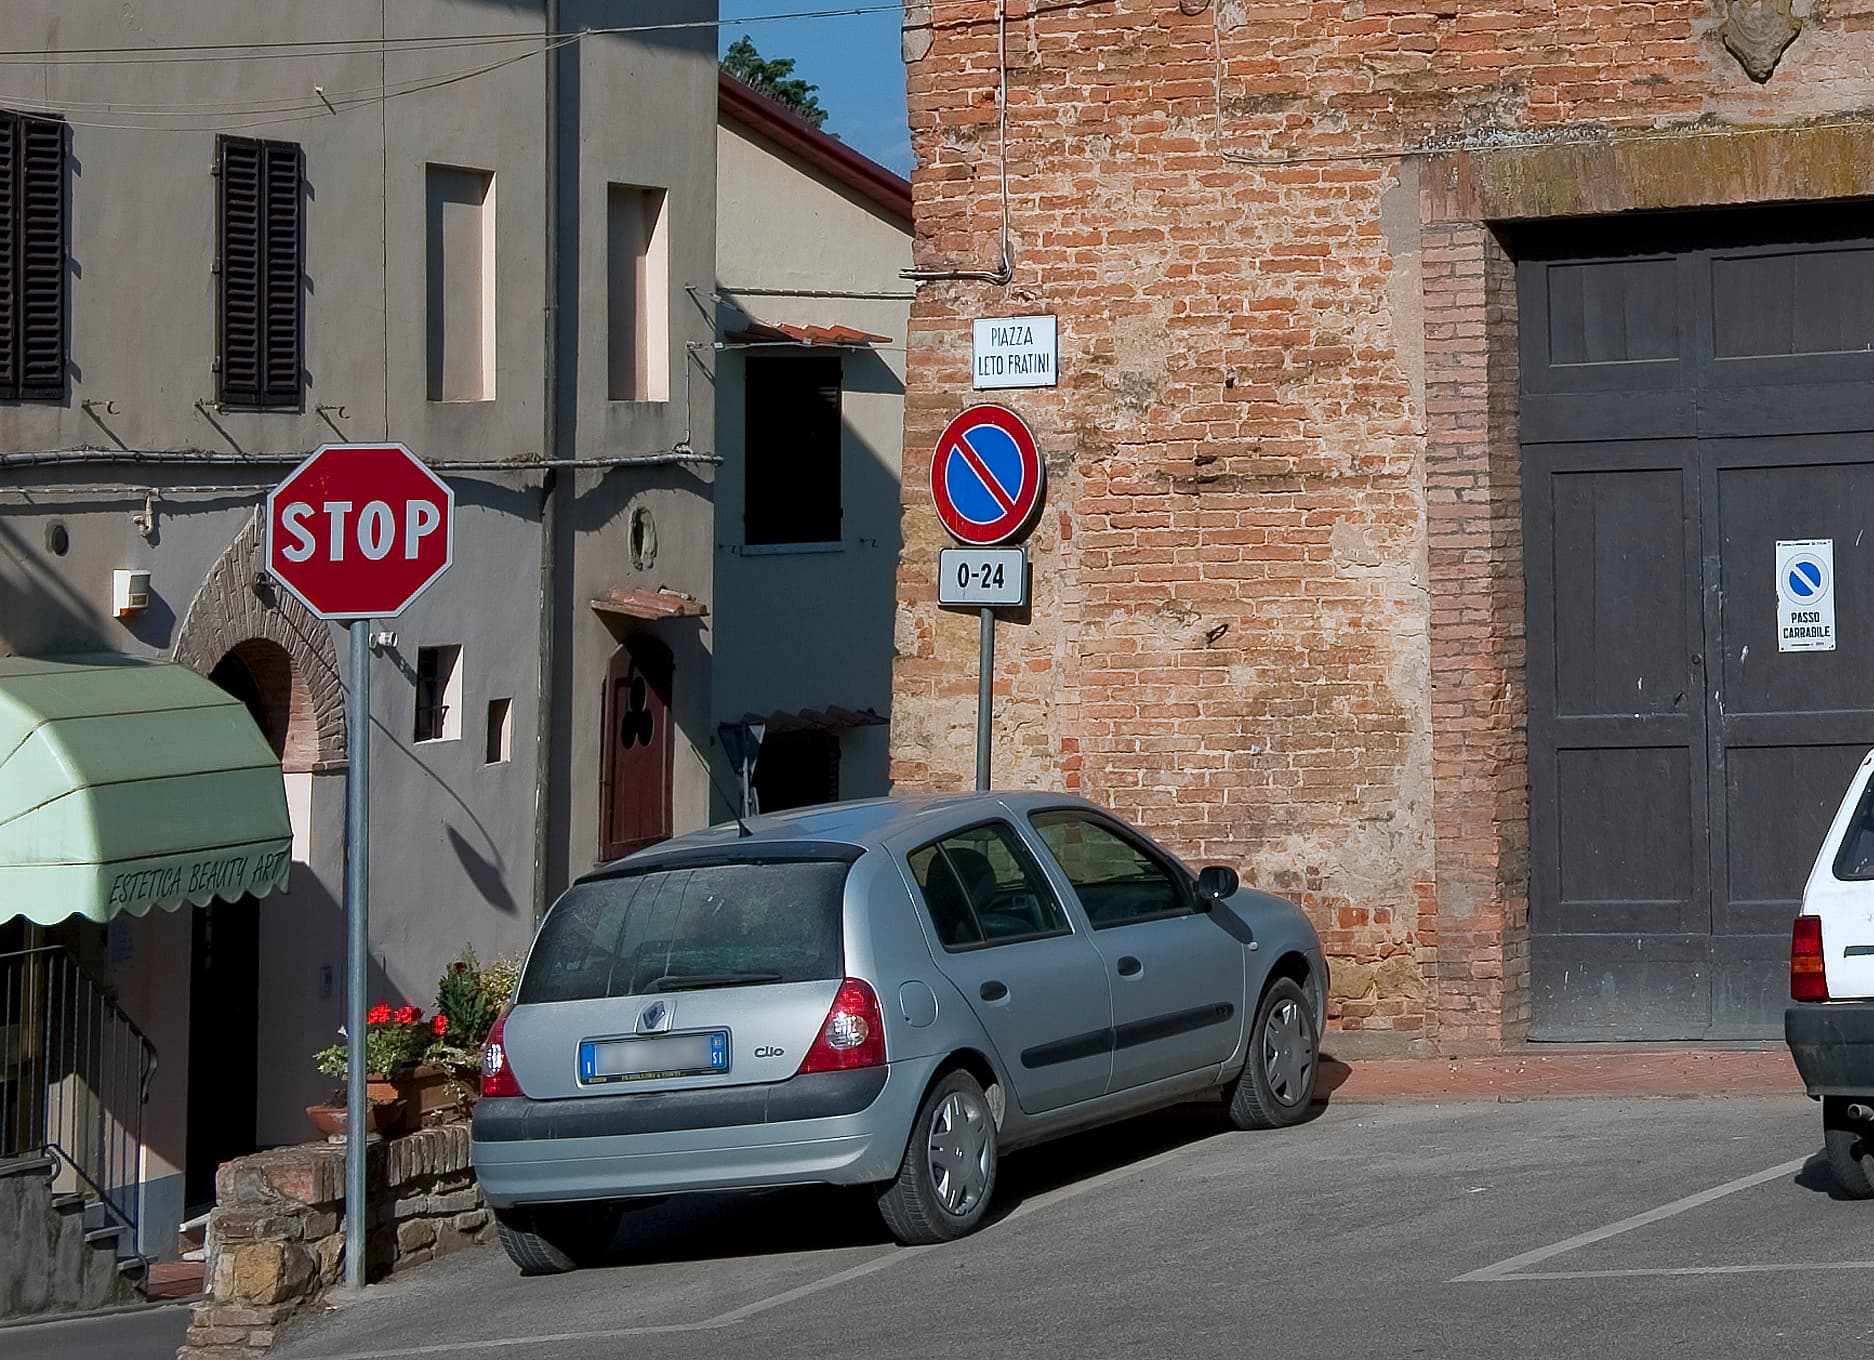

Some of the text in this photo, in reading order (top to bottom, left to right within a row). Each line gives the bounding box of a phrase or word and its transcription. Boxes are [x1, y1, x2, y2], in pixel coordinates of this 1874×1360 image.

[992, 326, 1034, 347] PIAZZA
[978, 353, 1050, 376] LETO FRATINI
[281, 499, 441, 563] STOP
[957, 562, 1005, 589] 0-24
[1791, 611, 1821, 624] PASSO
[1783, 625, 1831, 639] CARRABILE
[109, 866, 182, 905] ESTETICA
[188, 856, 249, 893] BEAUTY
[754, 1045, 785, 1058] Clio
